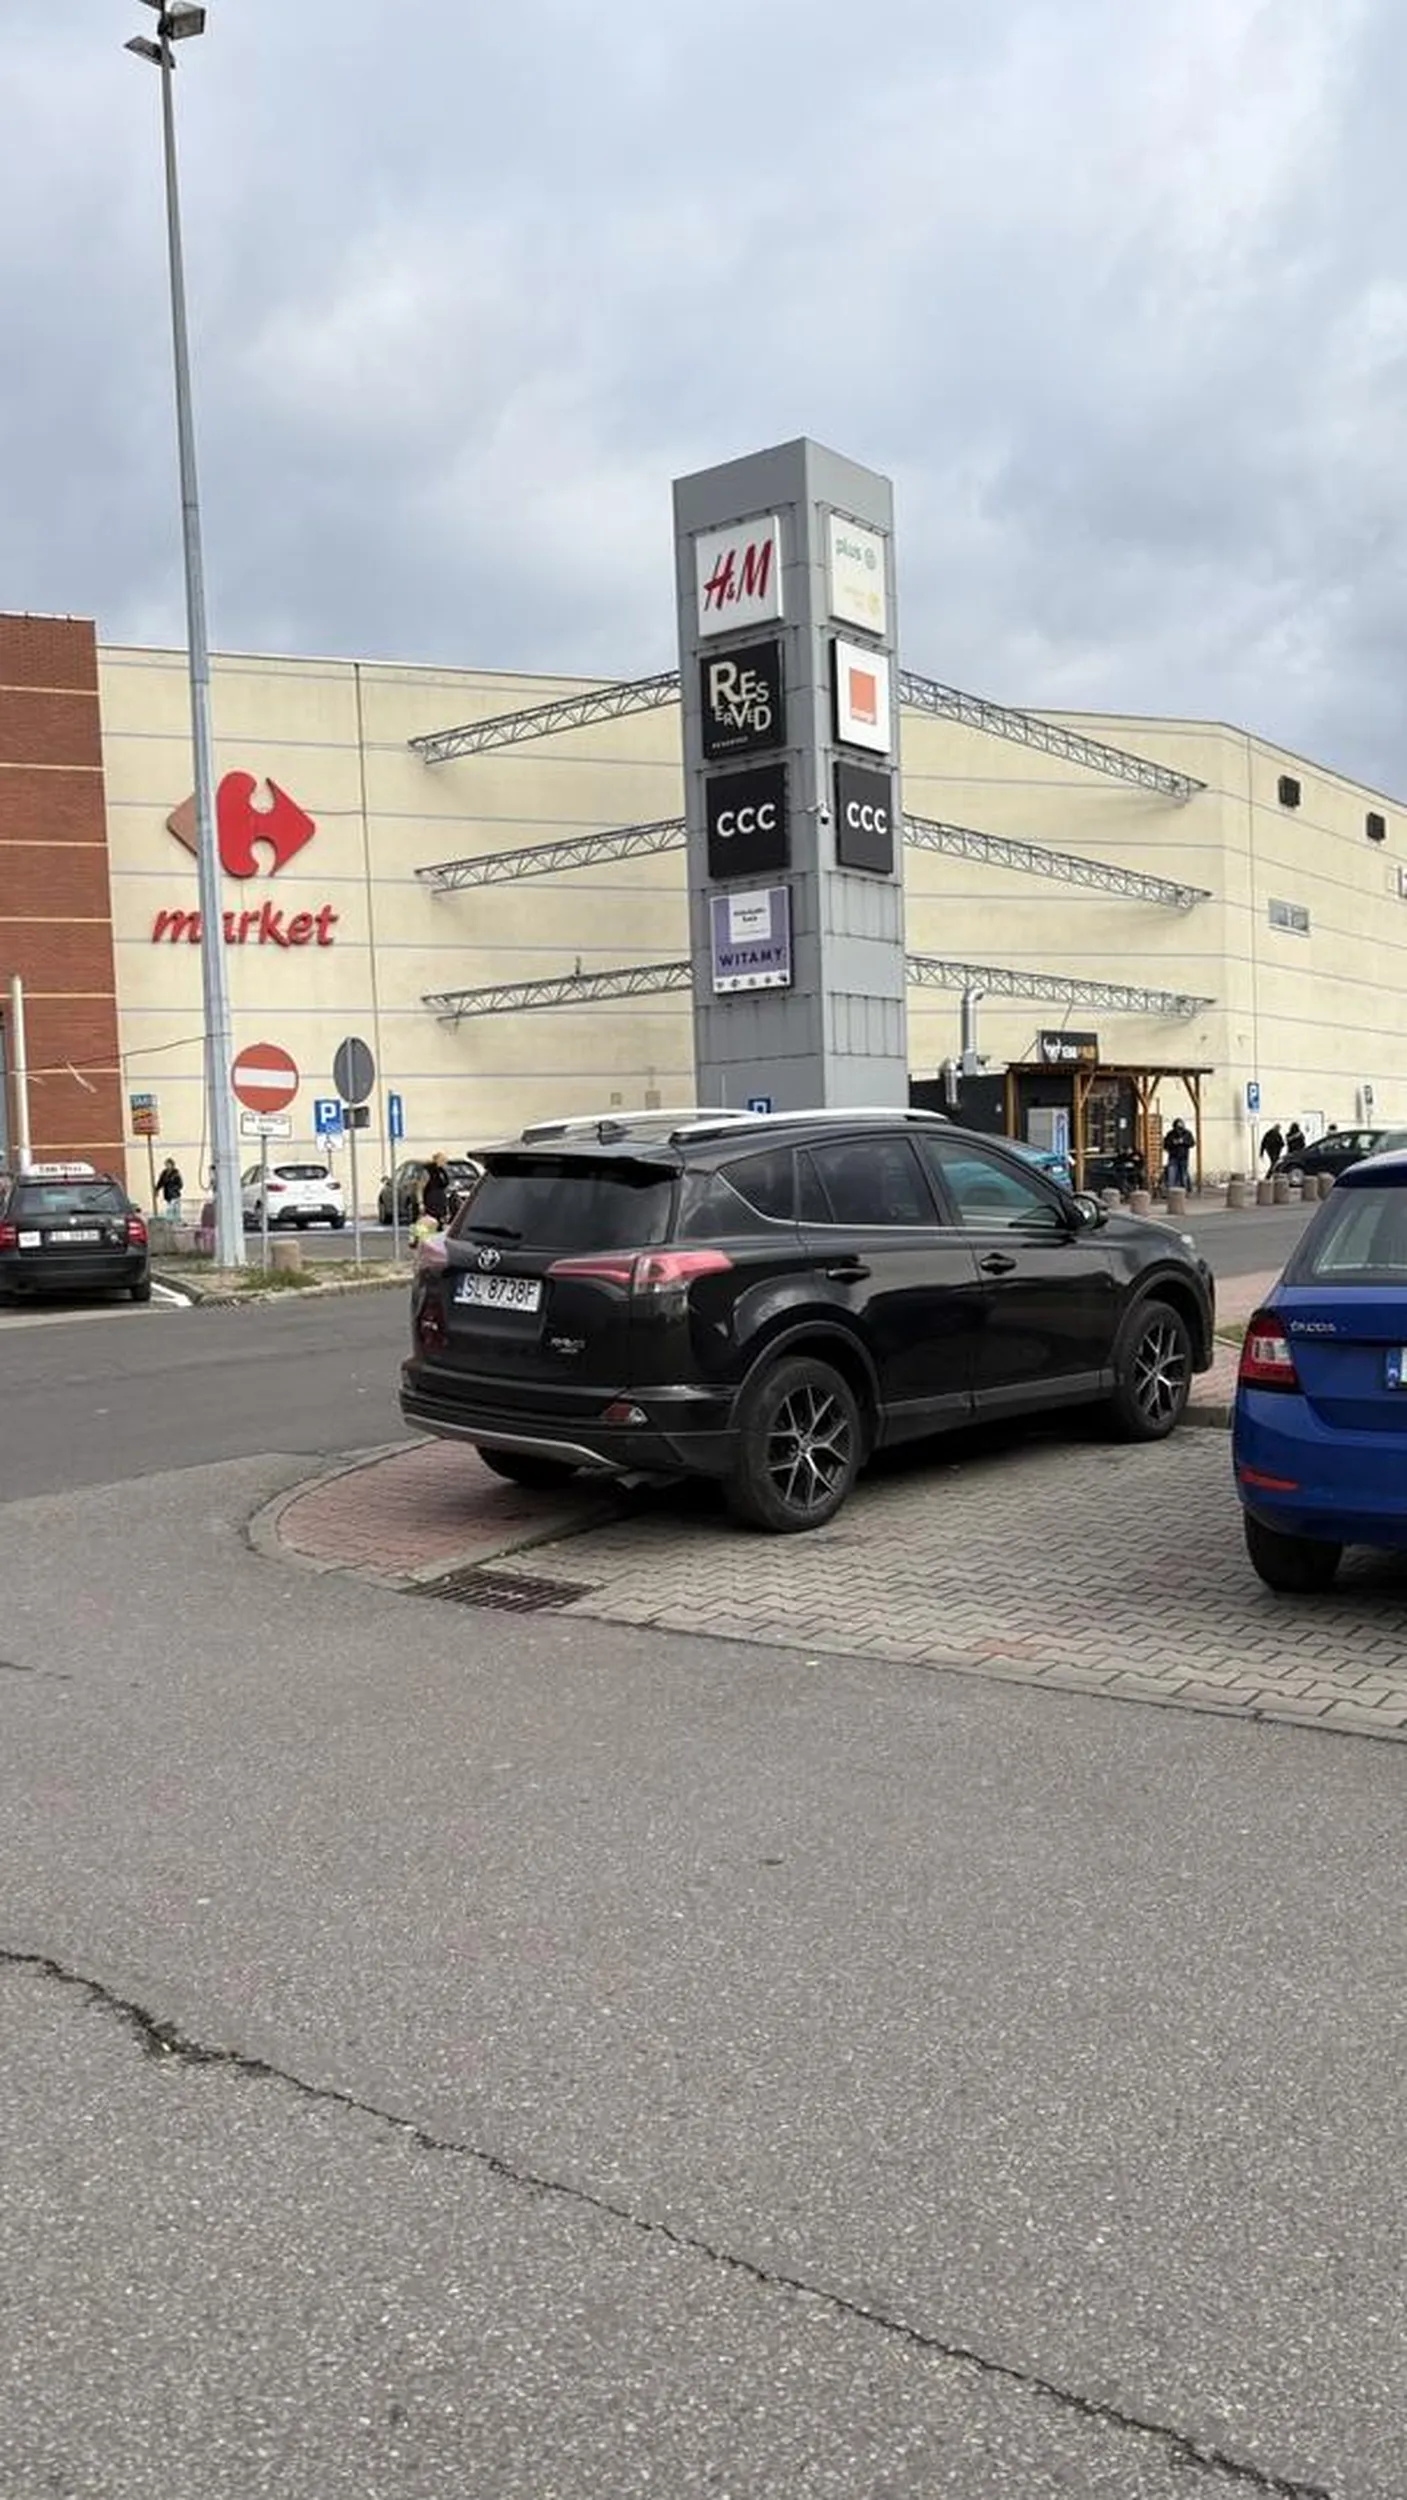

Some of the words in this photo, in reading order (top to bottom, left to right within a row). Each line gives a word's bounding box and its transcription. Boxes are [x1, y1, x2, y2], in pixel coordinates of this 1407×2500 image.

[703, 539, 772, 611] H&M
[717, 803, 777, 837] CCC
[847, 802, 888, 834] CCC
[718, 947, 783, 967] WITAMY
[320, 1103, 337, 1123] P
[466, 1275, 482, 1298] SL
[488, 1278, 537, 1304] 8738F
